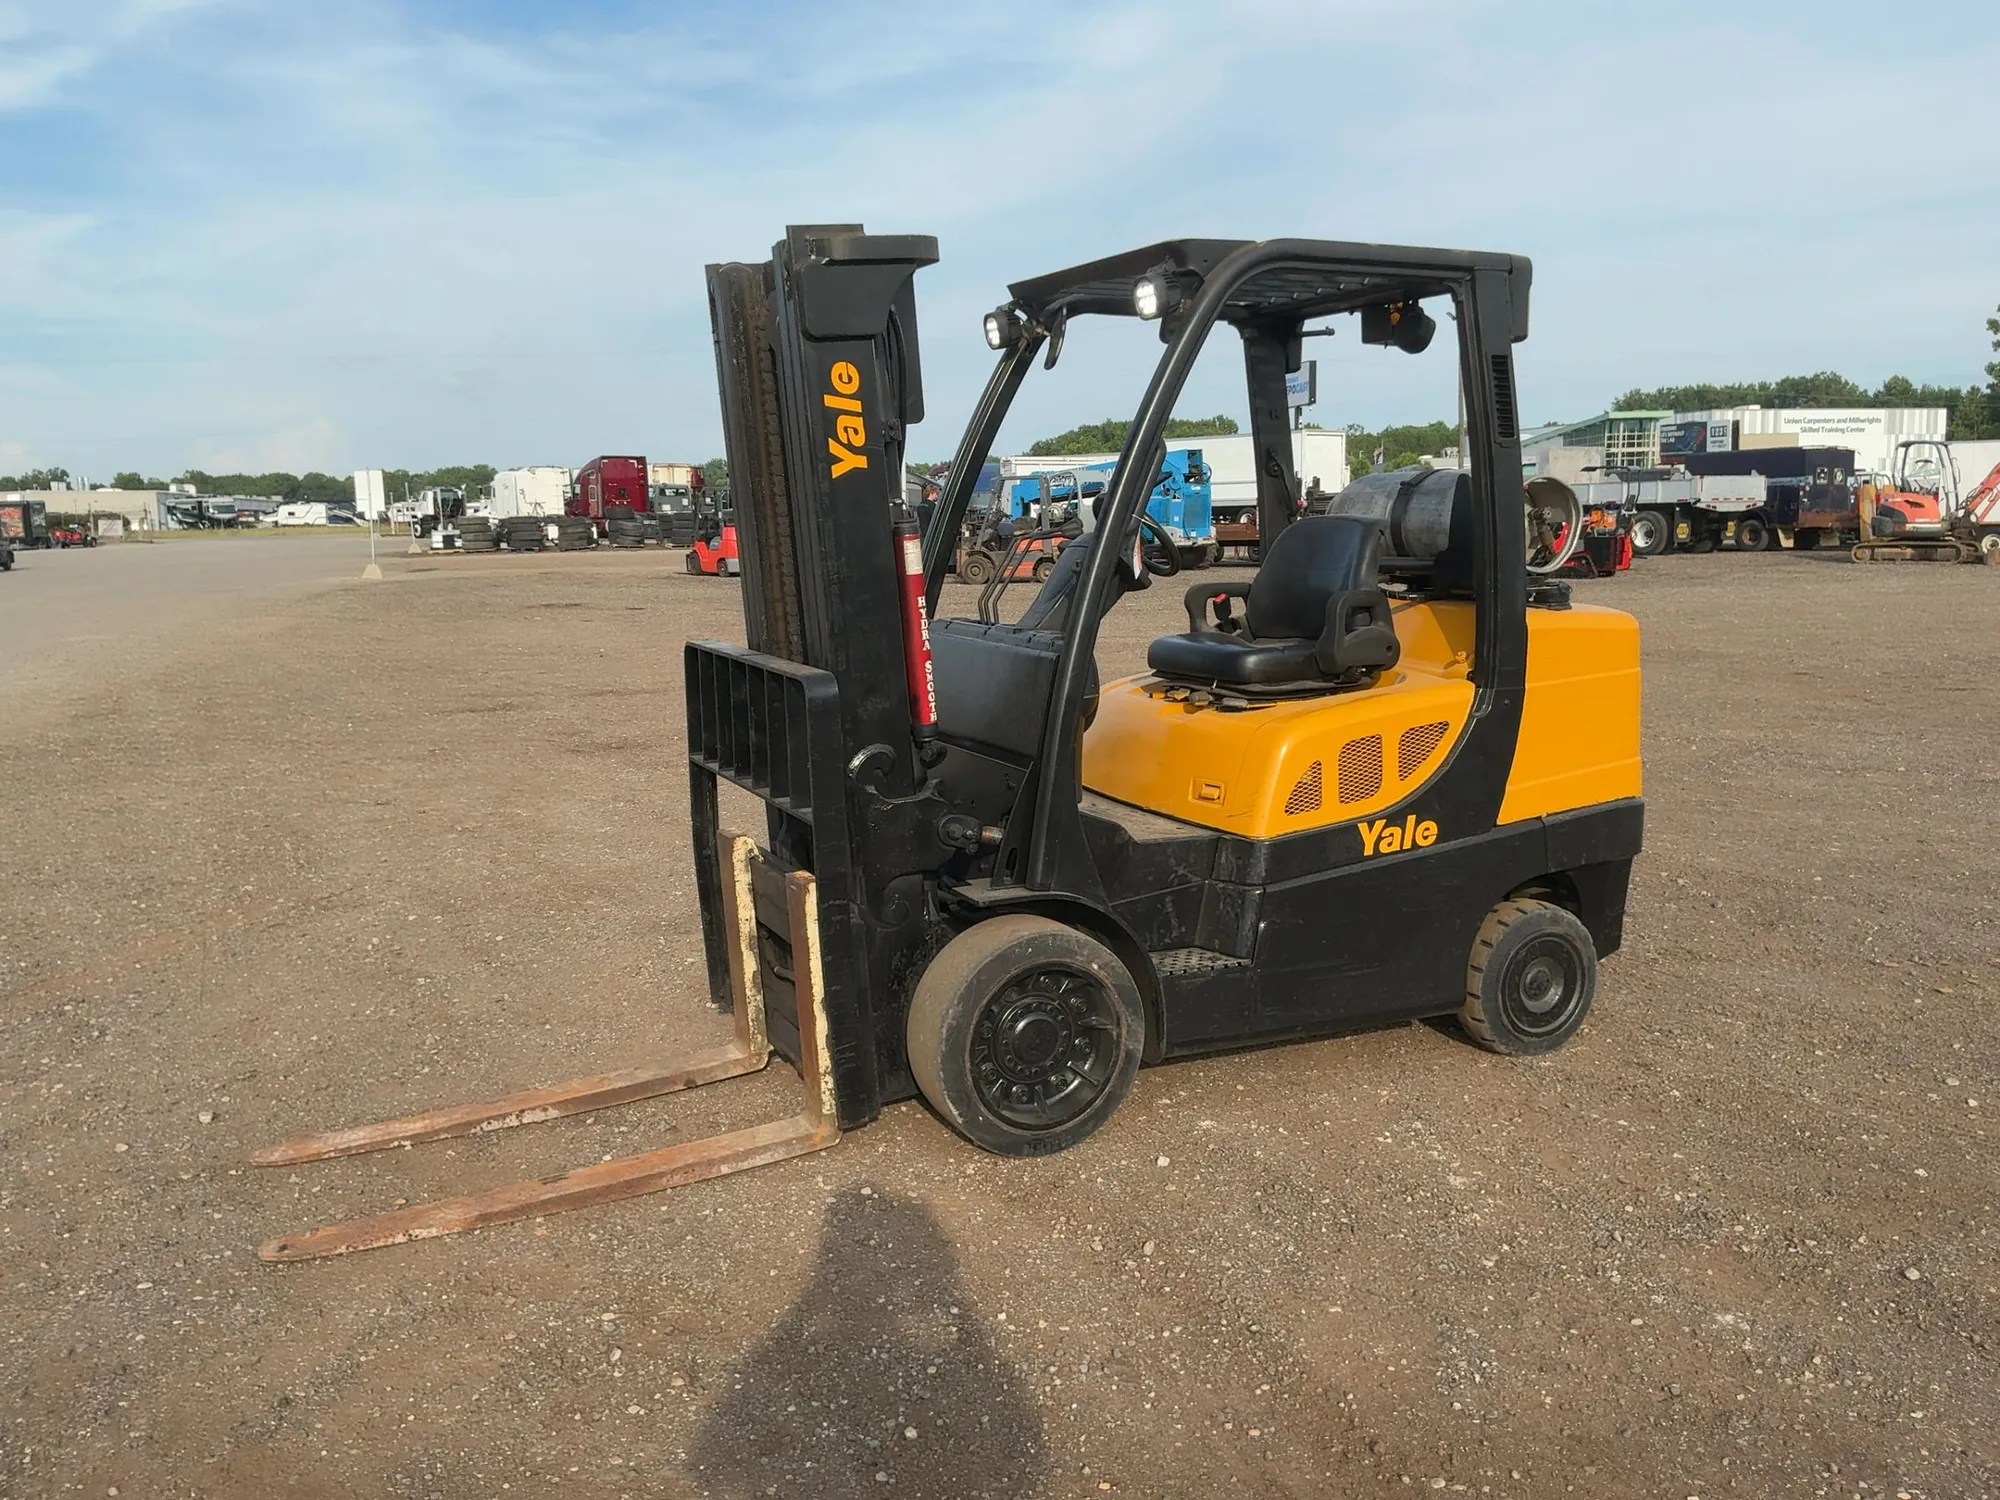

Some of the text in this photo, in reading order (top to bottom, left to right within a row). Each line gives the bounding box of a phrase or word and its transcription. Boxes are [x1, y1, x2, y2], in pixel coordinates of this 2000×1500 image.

[823, 361, 868, 479] Yale
[1803, 417, 1835, 426] Carpenters
[1848, 416, 1882, 425] Millwrights
[1821, 426, 1845, 435] Training
[917, 596, 937, 722] HYDRA SMOOTH
[1357, 814, 1438, 856] Yale
